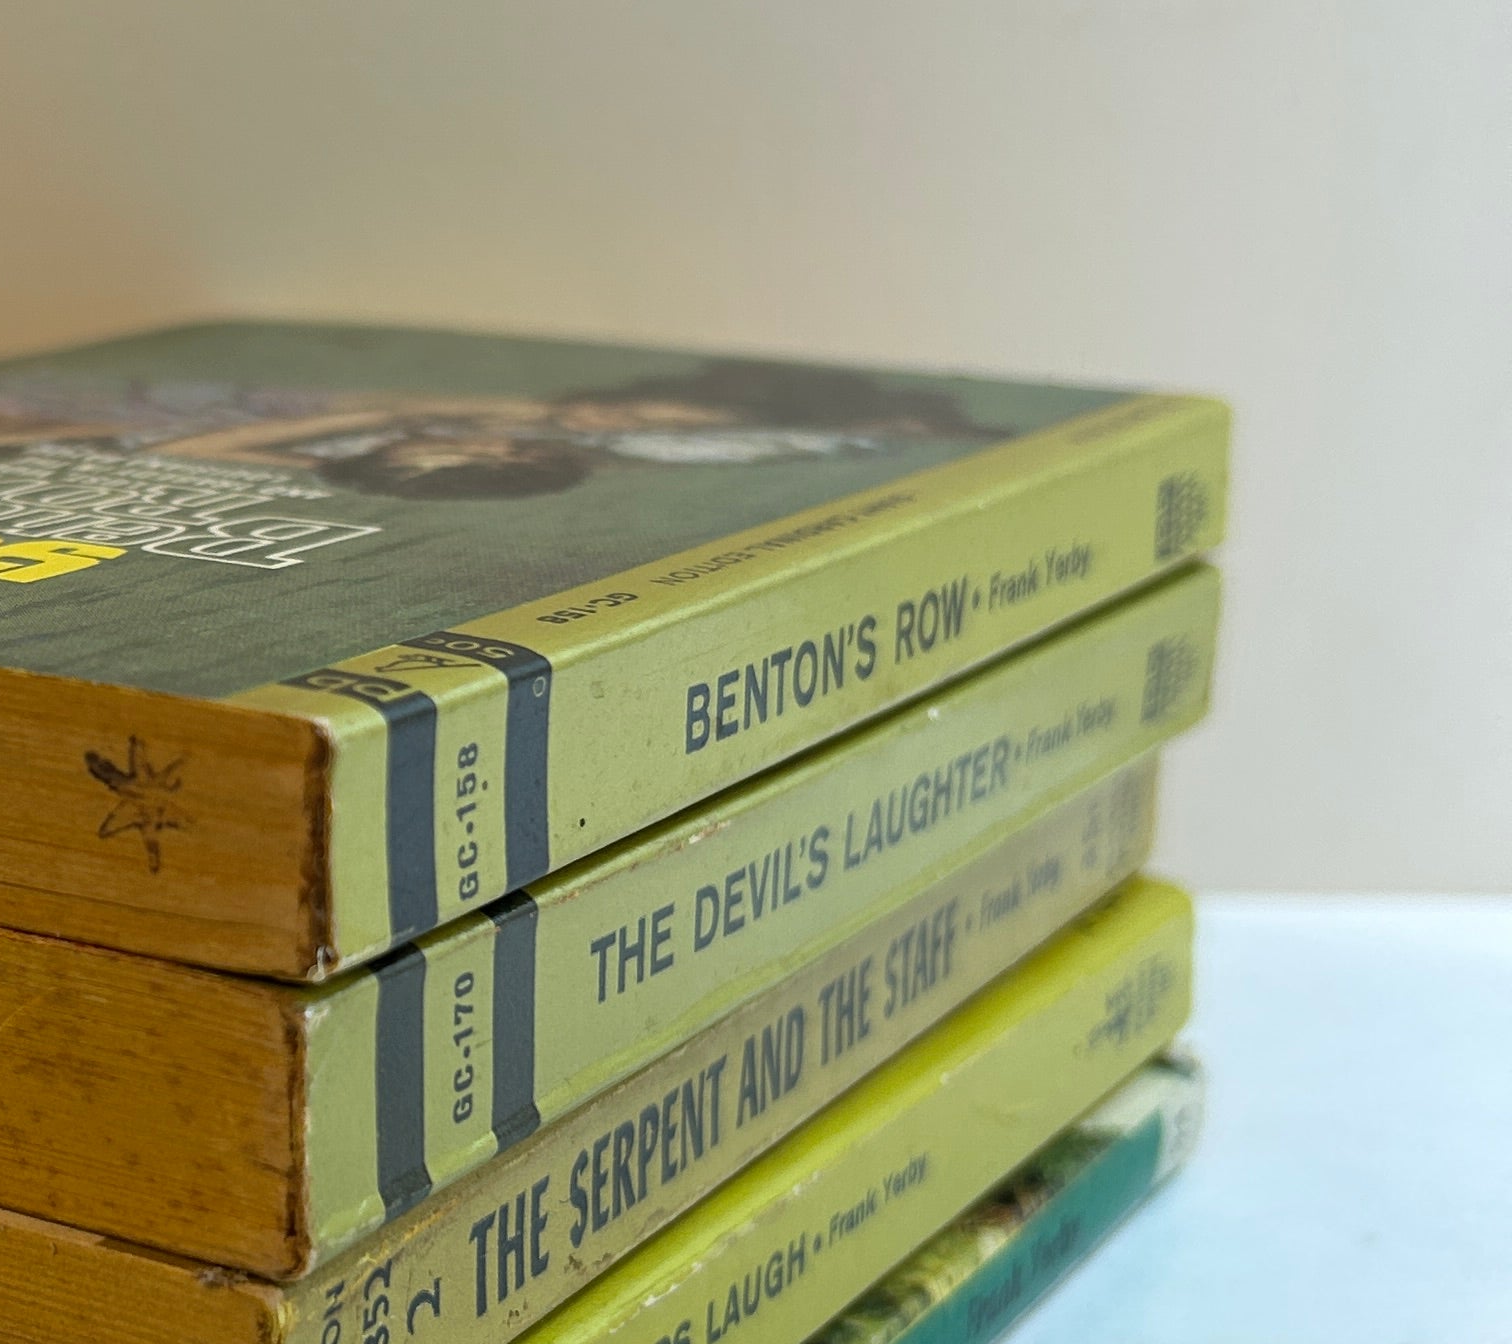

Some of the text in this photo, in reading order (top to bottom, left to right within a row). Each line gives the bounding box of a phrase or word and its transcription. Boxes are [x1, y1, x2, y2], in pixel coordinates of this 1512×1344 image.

[650, 550, 757, 587] EDITION
[686, 540, 1092, 755] BENTON'S ROW Frank Yerby
[590, 901, 675, 1003] THE
[693, 824, 830, 953] DEVIL'S
[843, 734, 1011, 871] LAUGHTER
[1026, 709, 1073, 764] Frank
[468, 1174, 551, 1318] THE
[569, 1053, 728, 1250] SERPENT
[736, 1006, 804, 1129] AND
[818, 955, 873, 1066] THE
[883, 896, 959, 1020] STAFF
[828, 1190, 878, 1244] Frank
[884, 1152, 928, 1206] Yerby
[406, 1276, 441, 1336] 2
